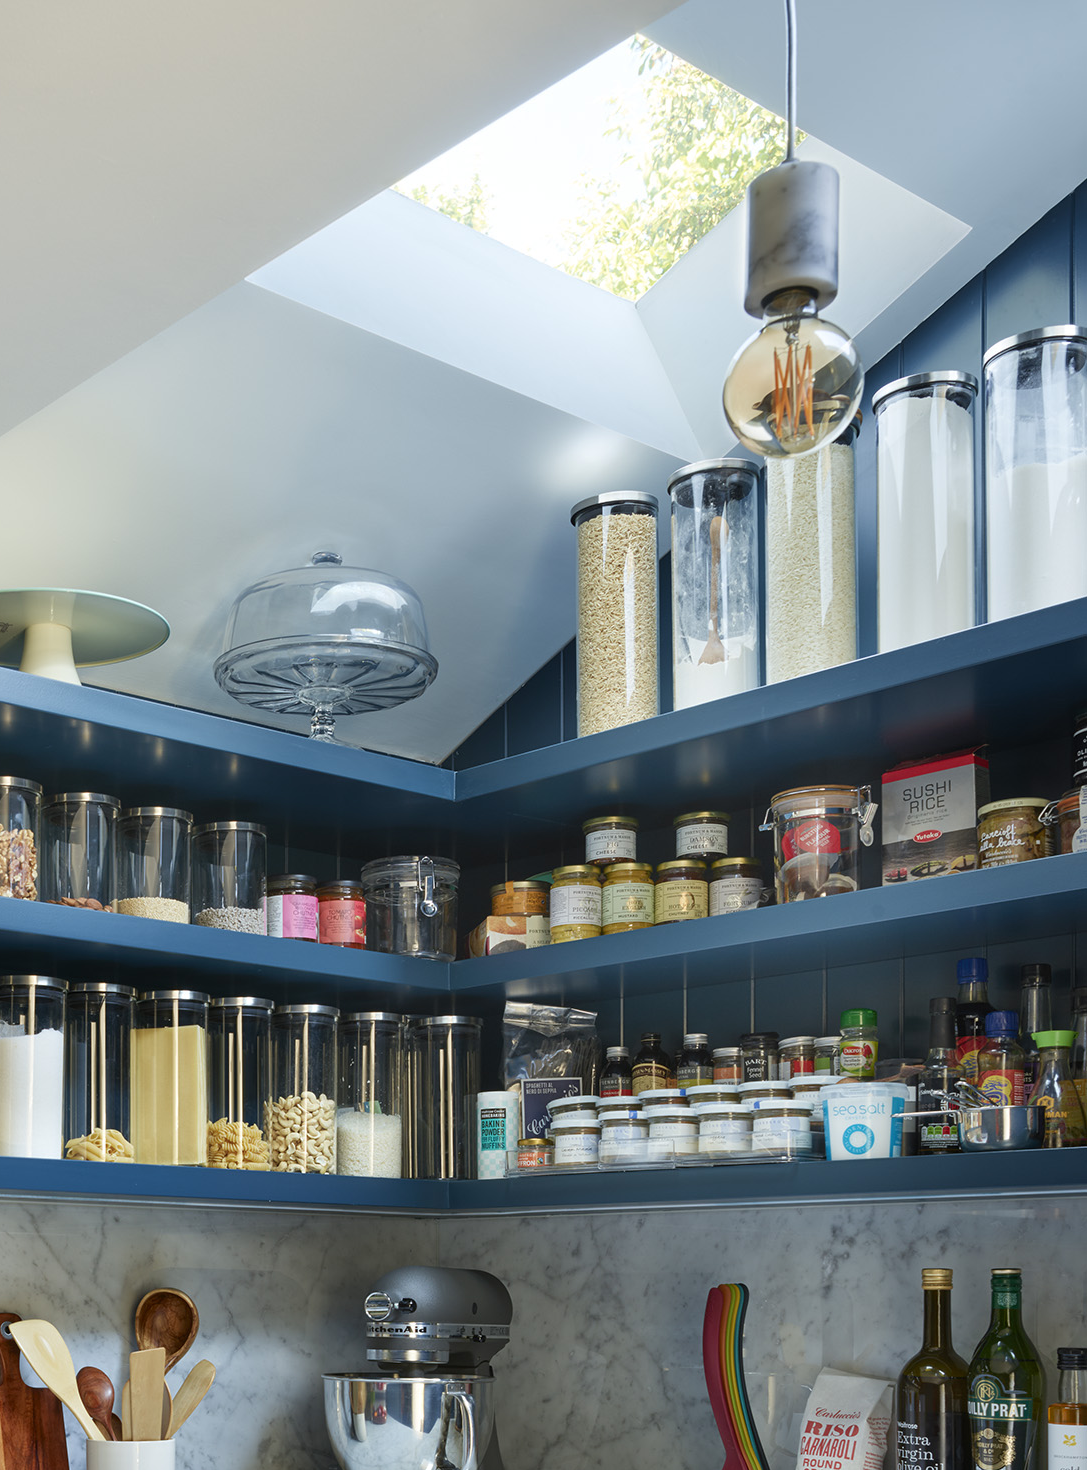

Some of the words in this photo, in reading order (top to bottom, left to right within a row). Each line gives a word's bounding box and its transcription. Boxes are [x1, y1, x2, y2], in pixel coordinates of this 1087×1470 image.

[902, 779, 952, 802] SUSHI
[909, 794, 947, 814] RICE
[916, 832, 940, 841] Yutaka
[744, 1057, 768, 1066] BART
[832, 1104, 858, 1116] sea
[859, 1102, 886, 1115] salt
[481, 1120, 505, 1128] BAKING
[481, 1128, 505, 1136] POWDER
[481, 1142, 505, 1150] MUFFINS
[815, 1406, 862, 1420] Carluccio's
[968, 1400, 990, 1417] ILLY
[990, 1403, 1026, 1418] PRAT
[804, 1420, 860, 1438] RISO
[897, 1430, 931, 1446] Extra
[800, 1436, 858, 1461] CARNAROLI
[897, 1446, 935, 1463] virgin
[802, 1458, 843, 1470] ROUND
